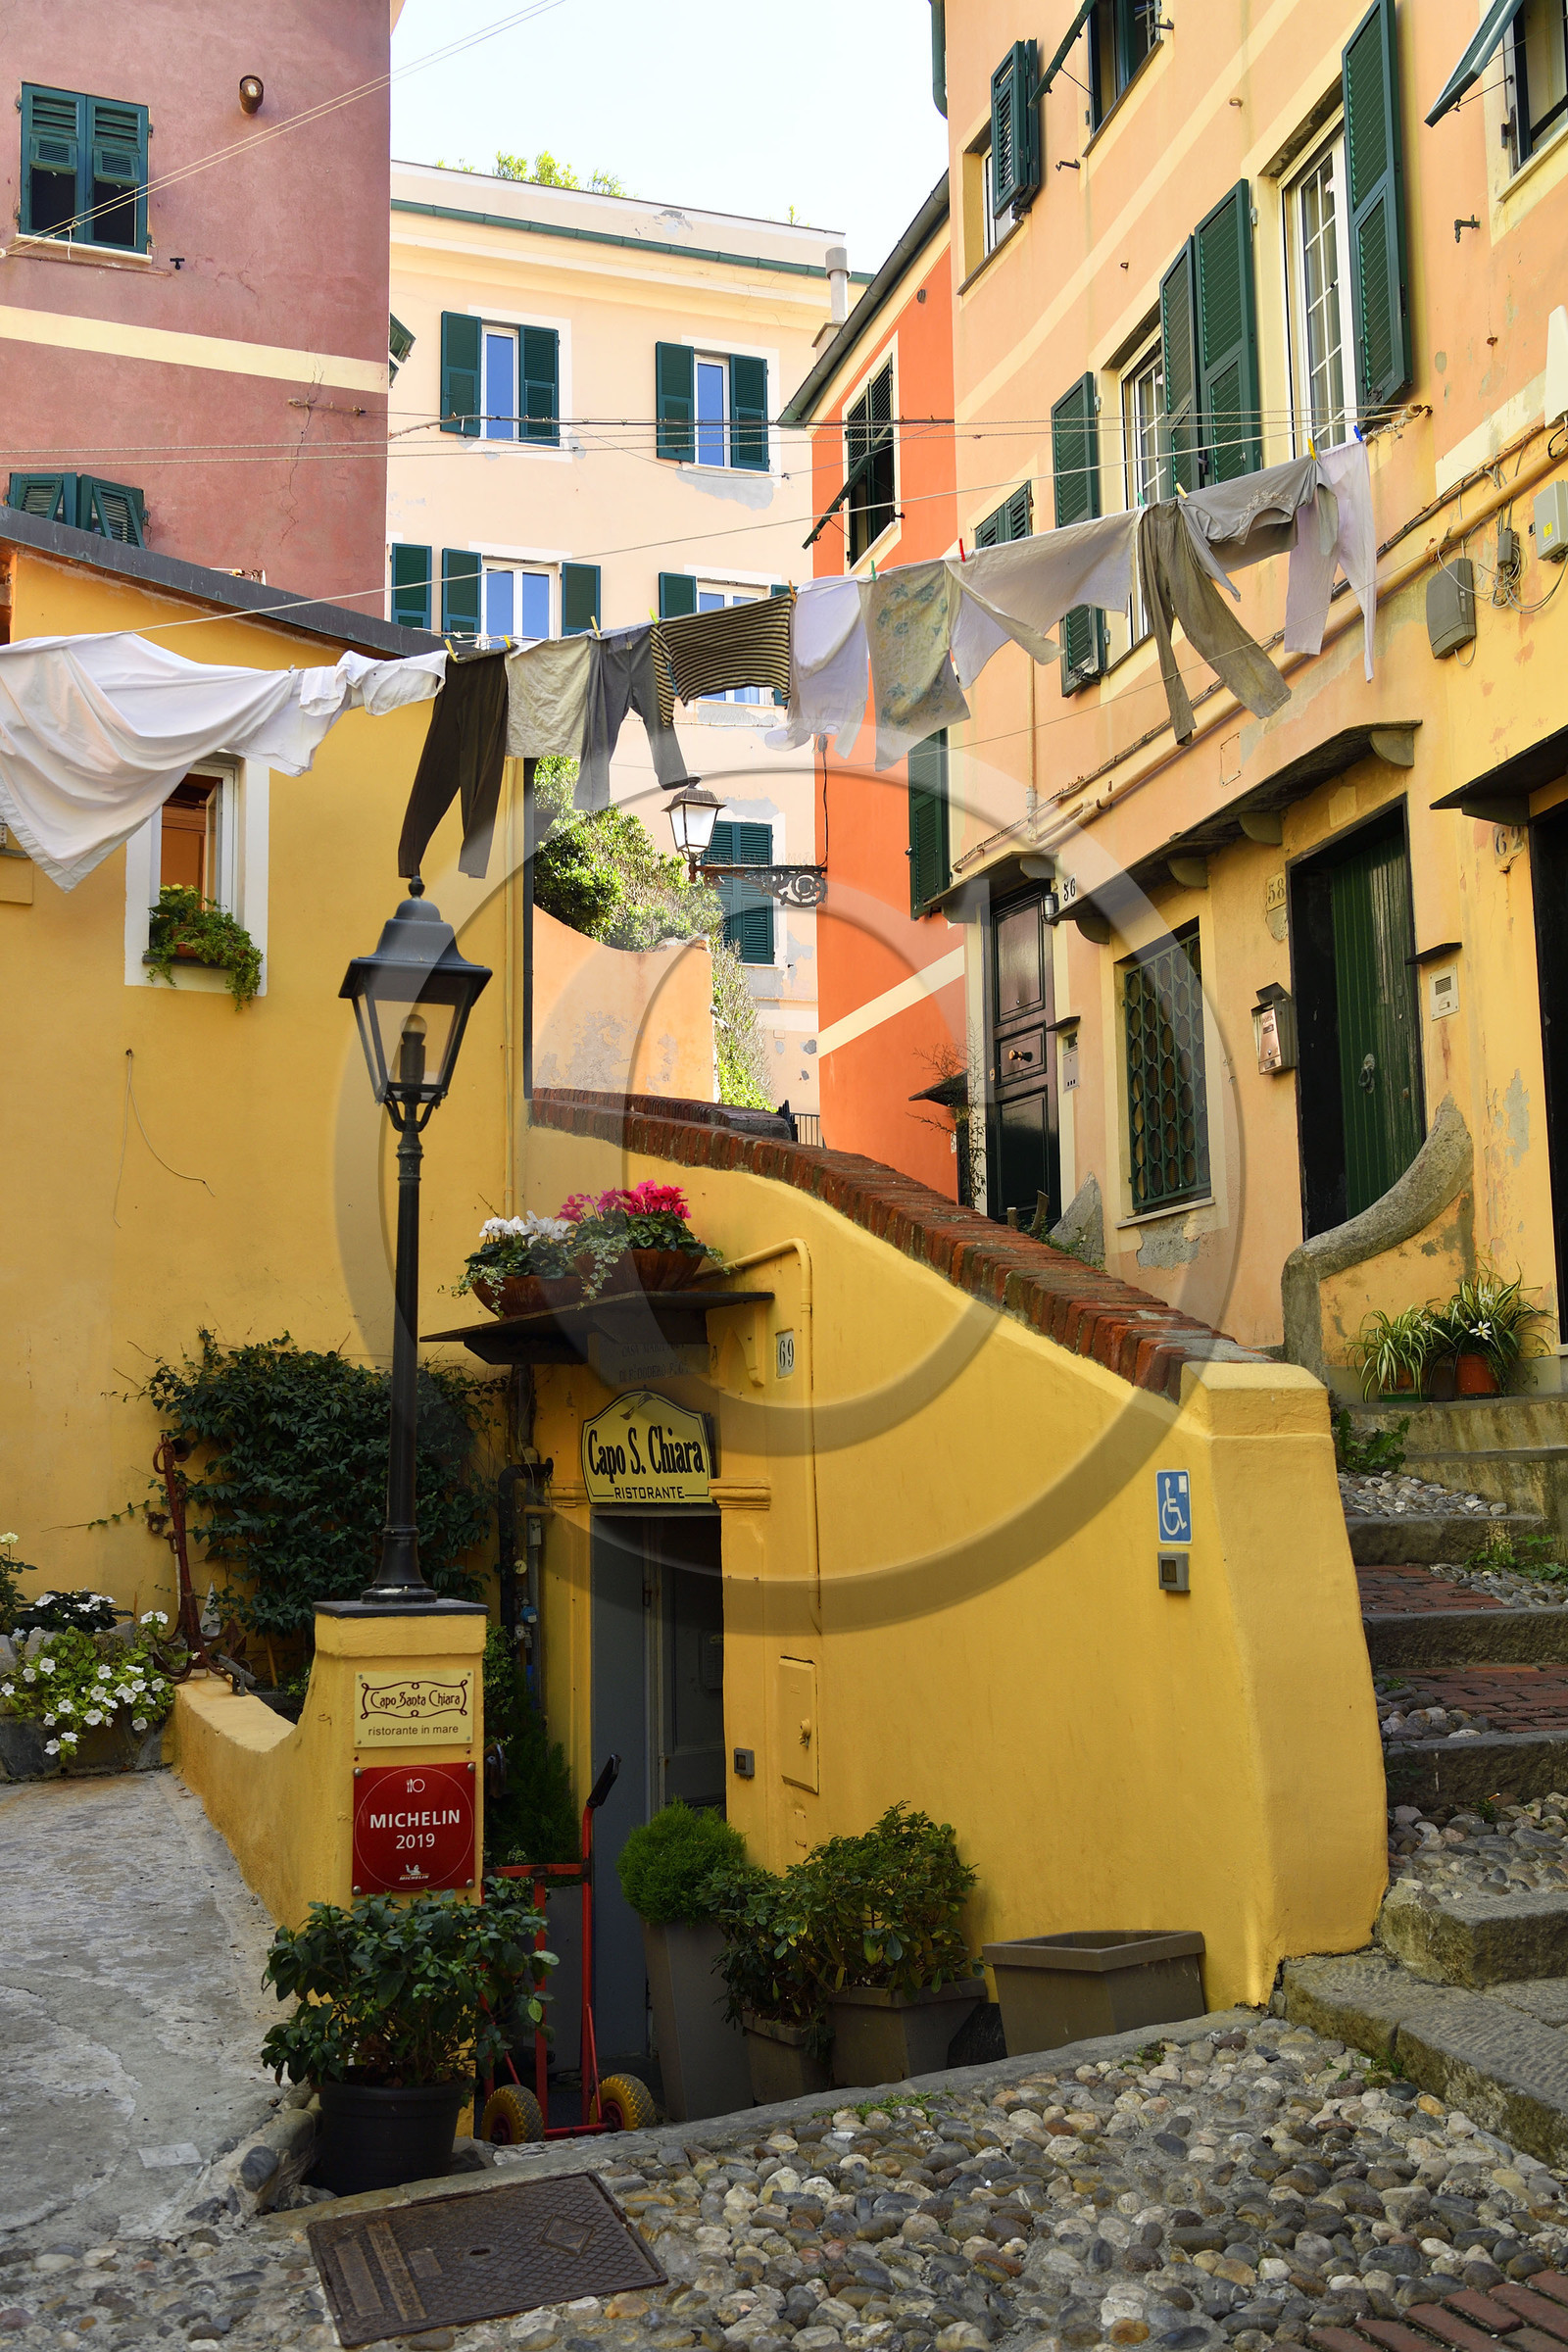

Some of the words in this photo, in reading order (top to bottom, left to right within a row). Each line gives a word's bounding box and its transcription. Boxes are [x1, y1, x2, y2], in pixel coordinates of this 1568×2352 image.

[1063, 877, 1076, 902] 56
[1267, 877, 1285, 905] 58
[779, 1339, 795, 1369] 69
[588, 1429, 626, 1485] Capo
[628, 1427, 647, 1475] S.
[648, 1425, 706, 1474] Chiara
[613, 1486, 685, 1499] RISTORANTE
[370, 1691, 397, 1709] Capo
[396, 1691, 426, 1709] Santa
[429, 1690, 461, 1707] Chiara
[368, 1726, 418, 1737] ristorante
[420, 1725, 430, 1735] in
[432, 1725, 459, 1735] mare
[369, 1809, 461, 1830] MICHELIN
[395, 1833, 435, 1850] 2019
